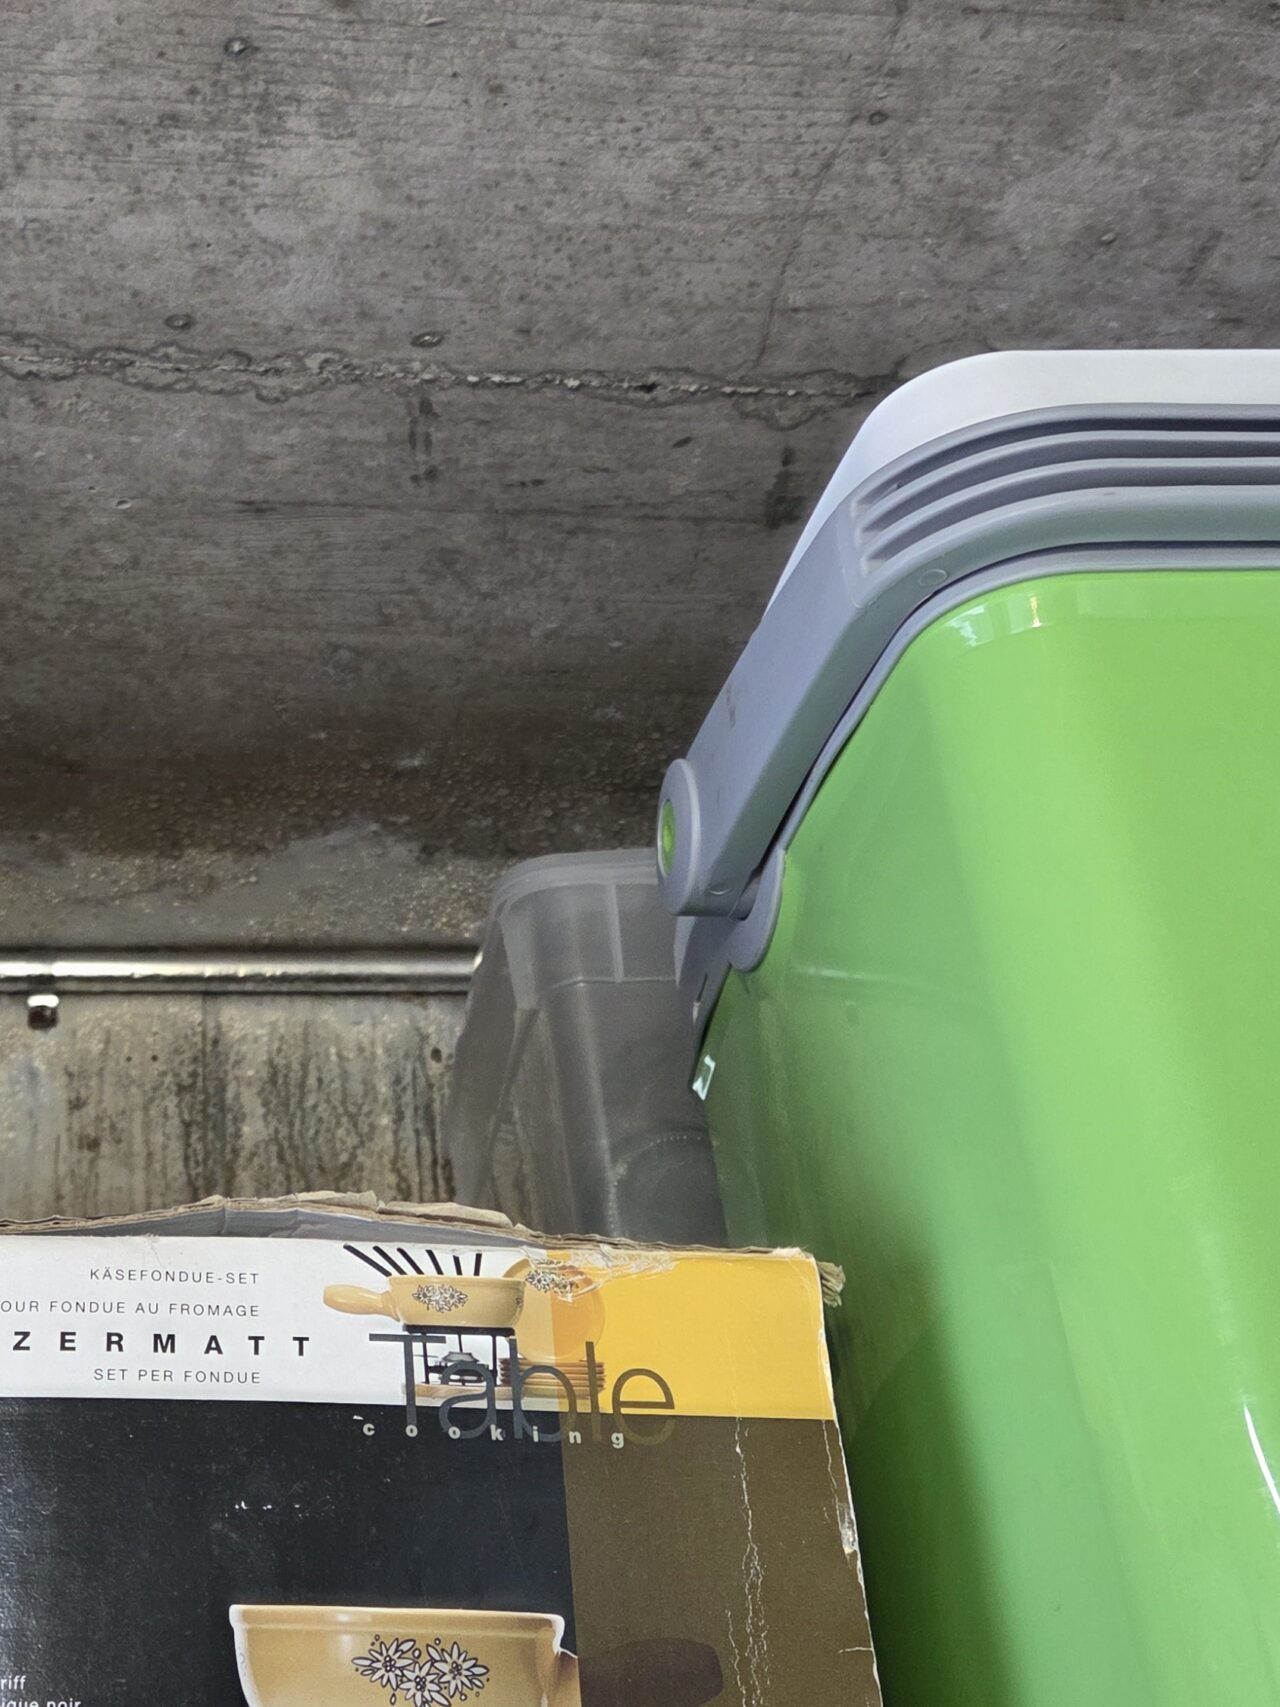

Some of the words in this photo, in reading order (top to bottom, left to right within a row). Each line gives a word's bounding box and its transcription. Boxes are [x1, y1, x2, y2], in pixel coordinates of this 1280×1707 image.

[90, 1267, 260, 1285] KÄSEFONDUE-SET
[50, 1301, 126, 1315] FONDUE
[135, 1302, 160, 1316] AU
[169, 1303, 260, 1318] FROMAGE
[12, 1331, 310, 1357] ZERMATT
[93, 1368, 129, 1382] SET
[138, 1369, 173, 1382] PER
[183, 1370, 261, 1384] FONDUE
[369, 1333, 675, 1446] Table
[362, 1422, 625, 1449] cooking
